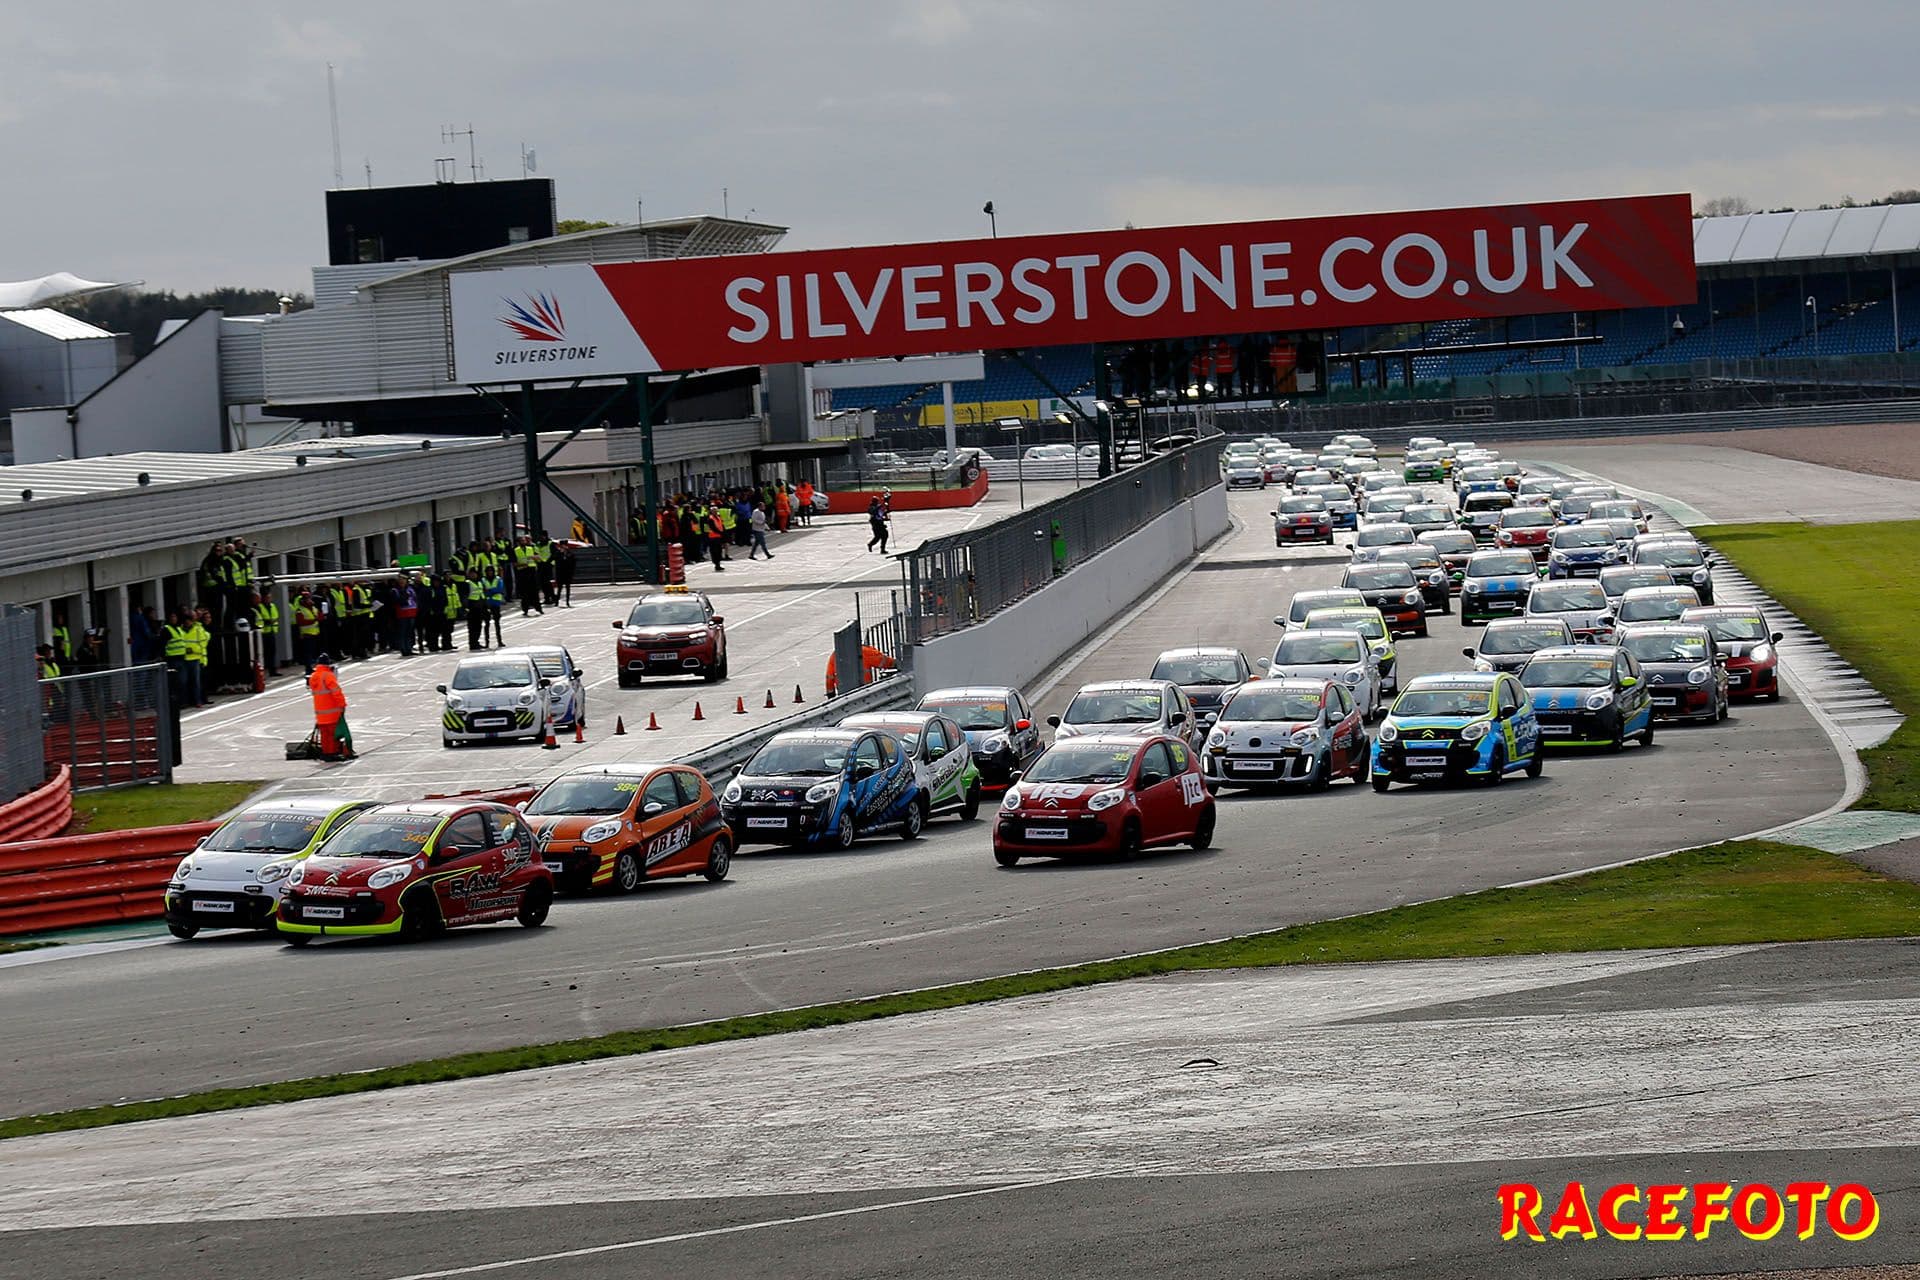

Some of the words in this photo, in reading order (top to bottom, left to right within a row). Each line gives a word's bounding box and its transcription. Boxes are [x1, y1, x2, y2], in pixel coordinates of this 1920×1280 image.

[725, 221, 1596, 345] SILVERSTONE.CO.UK
[494, 345, 598, 365] SILVERSTONE
[259, 813, 315, 822] DISTRIGO
[375, 816, 432, 824] DISTRIGO
[402, 833, 429, 843] 349
[449, 870, 501, 899] RAW
[304, 885, 329, 896] SME
